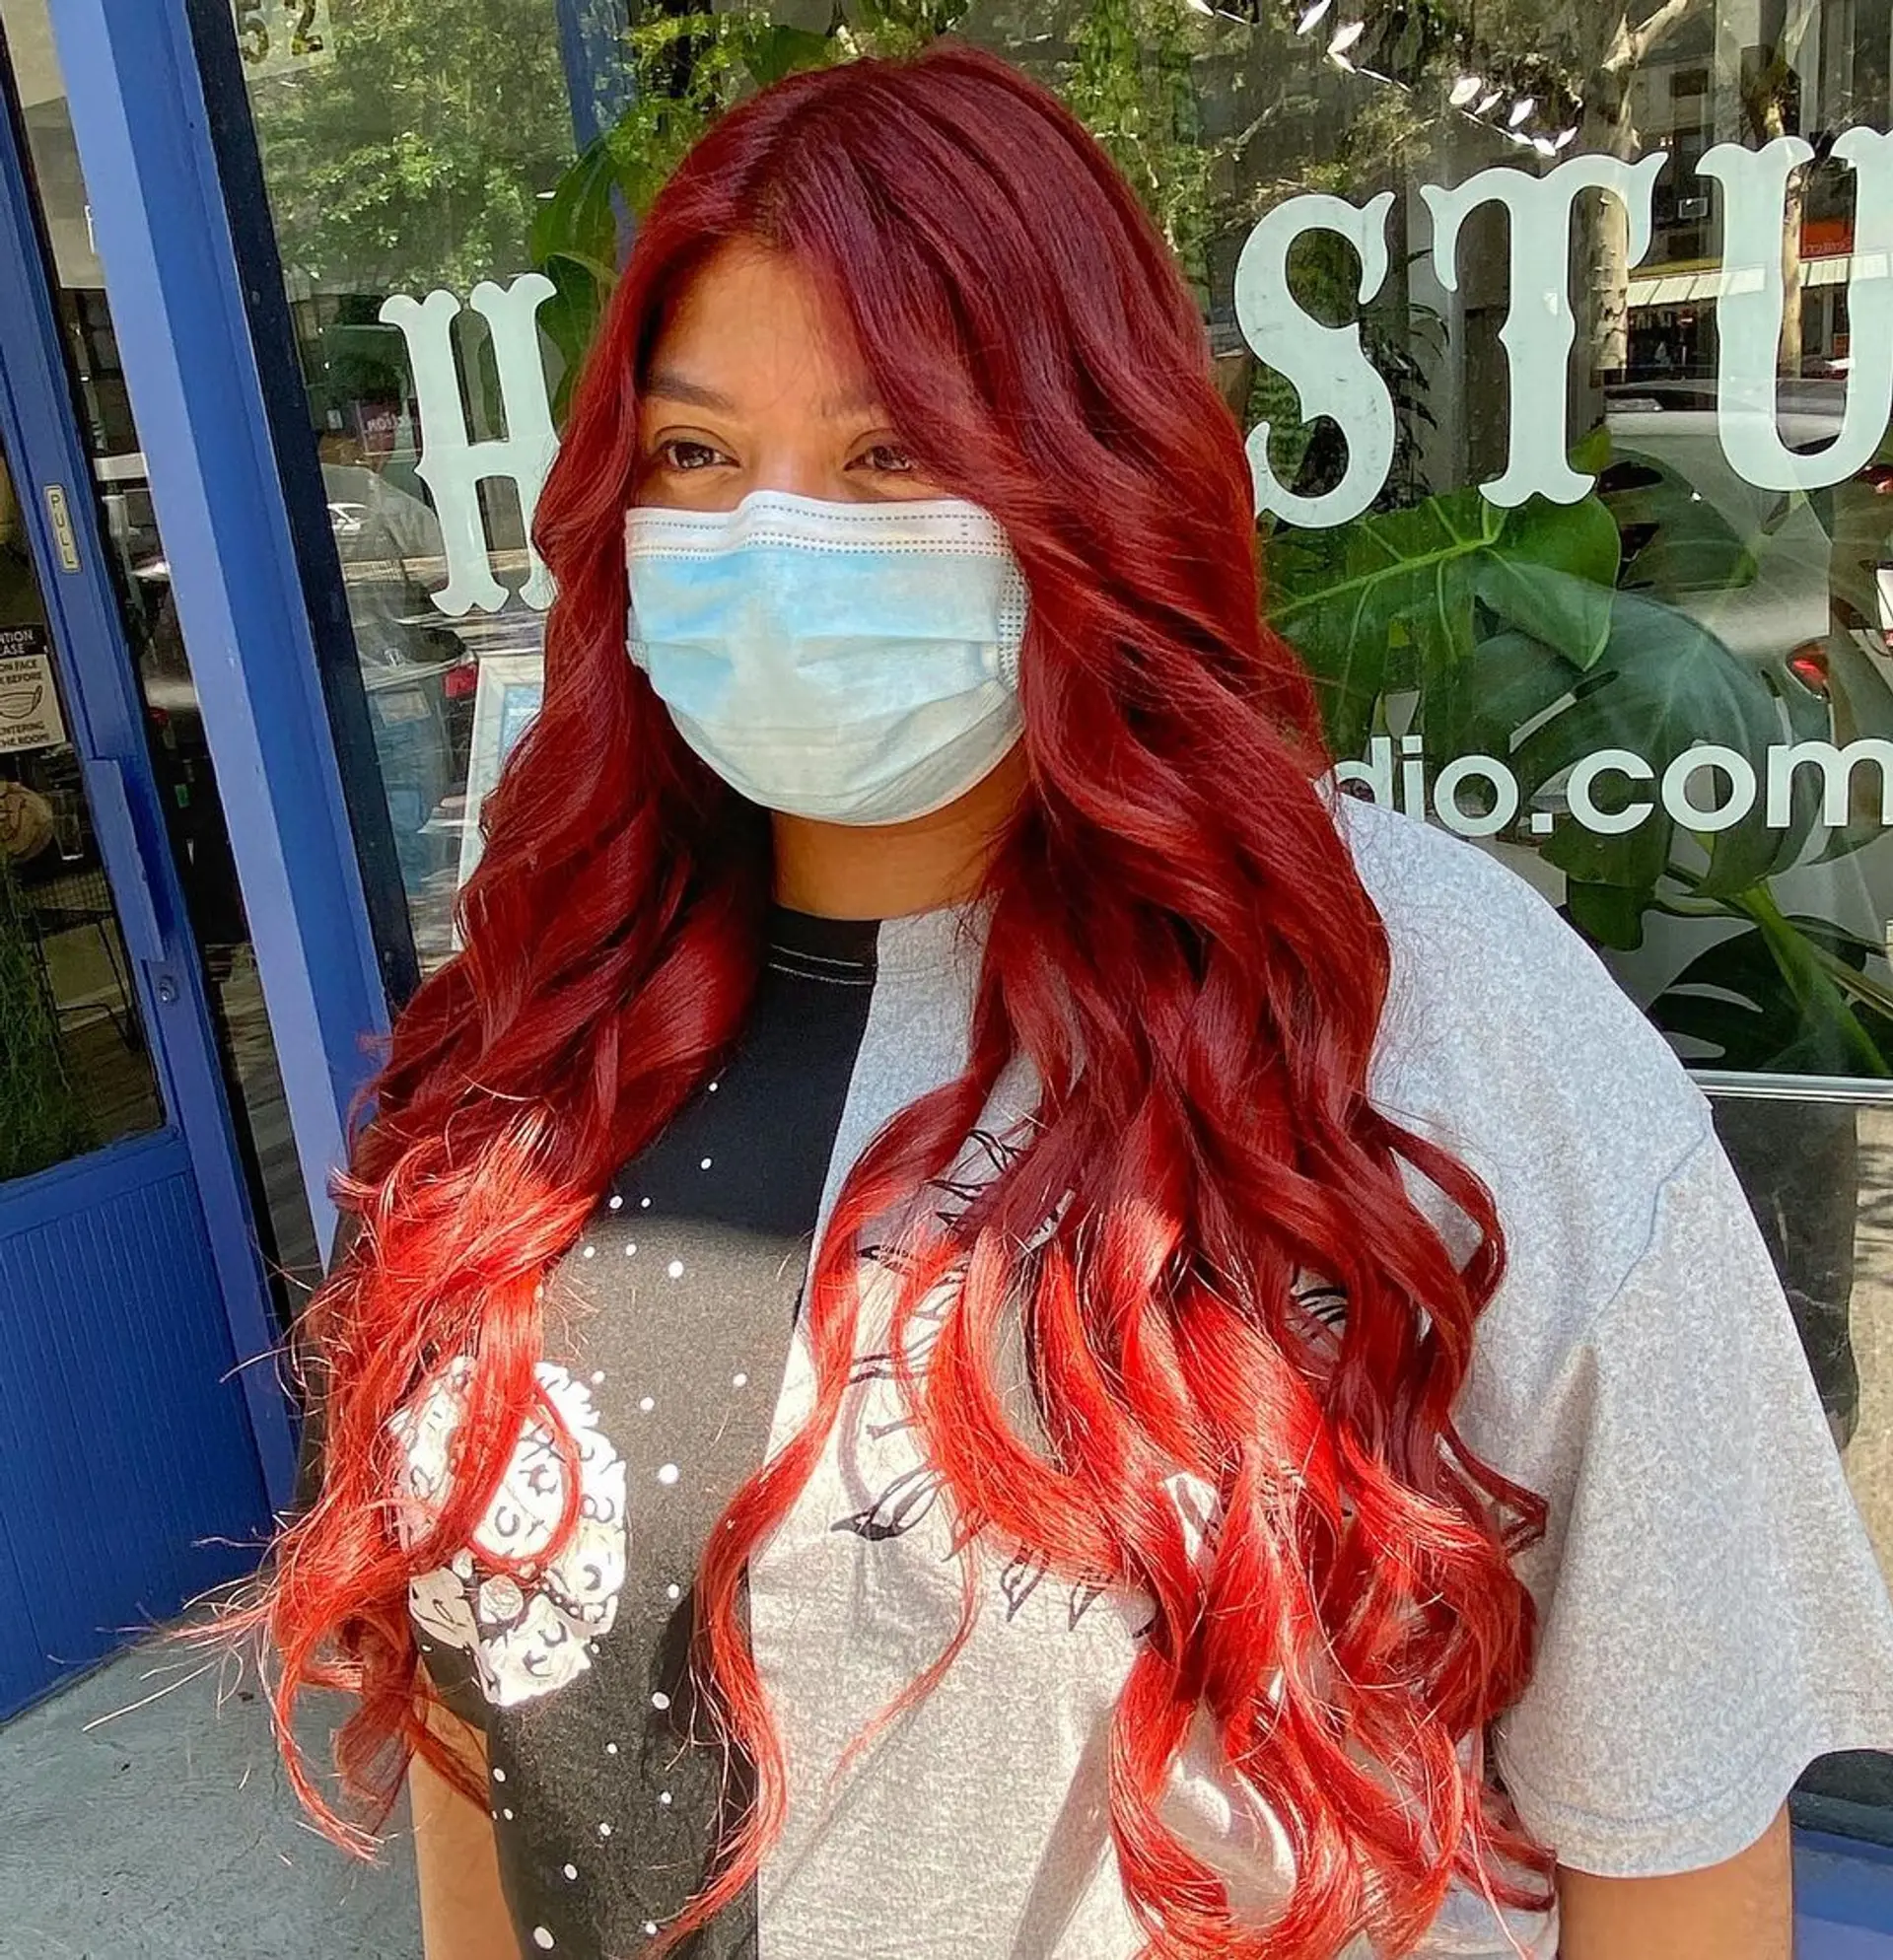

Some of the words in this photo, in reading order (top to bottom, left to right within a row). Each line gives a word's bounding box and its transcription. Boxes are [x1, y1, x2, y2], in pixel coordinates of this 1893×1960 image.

[1234, 126, 1893, 528] STU
[50, 494, 75, 564] PULL
[6, 671, 41, 683] BEFORE
[14, 659, 36, 670] FACE
